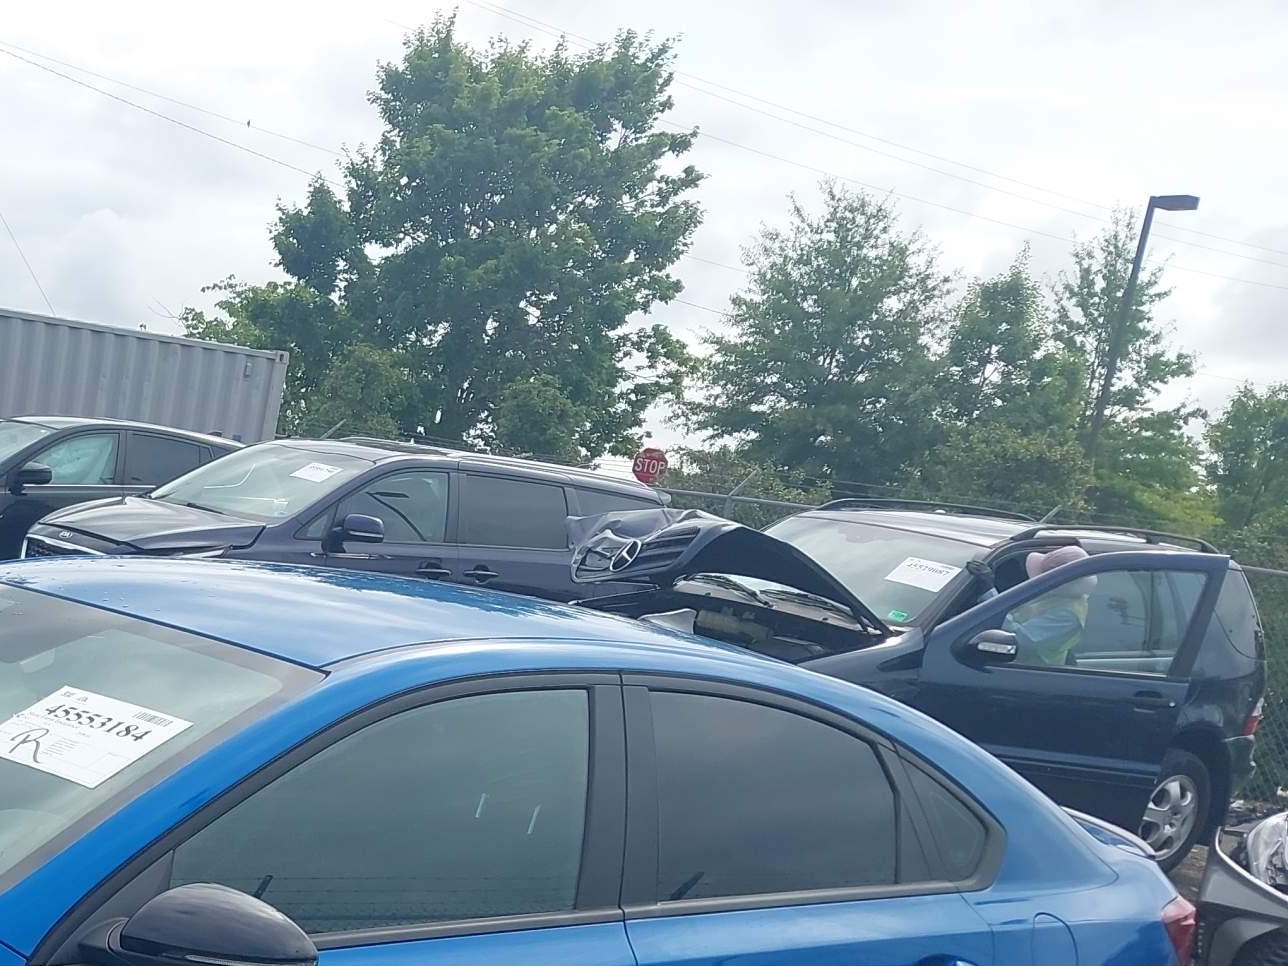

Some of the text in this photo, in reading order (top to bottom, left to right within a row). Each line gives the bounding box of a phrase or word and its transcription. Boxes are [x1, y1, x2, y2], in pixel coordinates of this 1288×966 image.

[634, 458, 666, 475] STOP
[45, 704, 153, 742] 45553184
[8, 728, 49, 763] R
